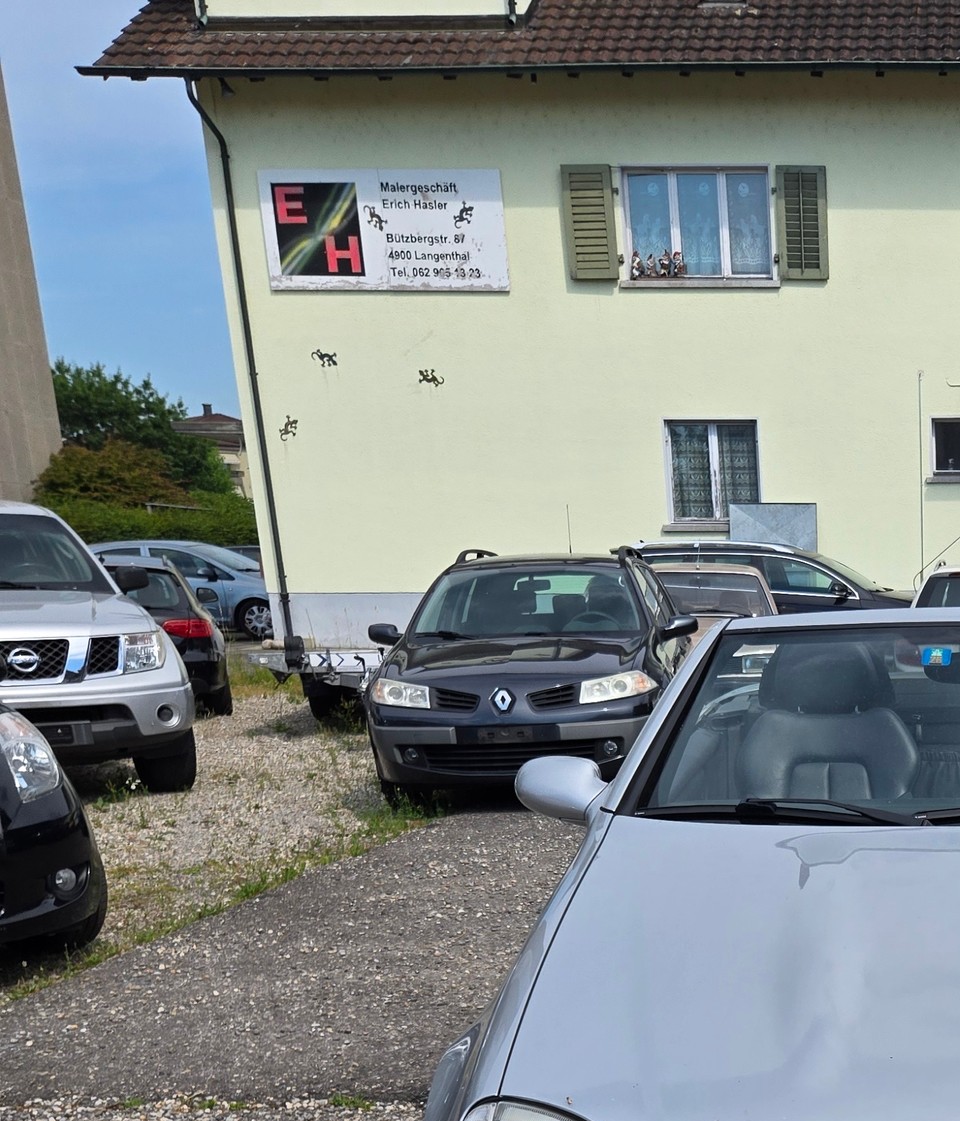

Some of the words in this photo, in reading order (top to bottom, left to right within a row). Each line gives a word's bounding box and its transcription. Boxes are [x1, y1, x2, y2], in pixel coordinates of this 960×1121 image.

[380, 182, 458, 195] Malergeschäft
[274, 186, 308, 225] E
[382, 199, 411, 210] Erich
[413, 199, 448, 210] Hasler
[386, 233, 451, 246] Bützbergstr.
[324, 236, 362, 273] H
[388, 250, 412, 261] 4900
[414, 251, 470, 263] Langenthal
[390, 266, 410, 278] Tel.
[412, 267, 431, 278] 062
